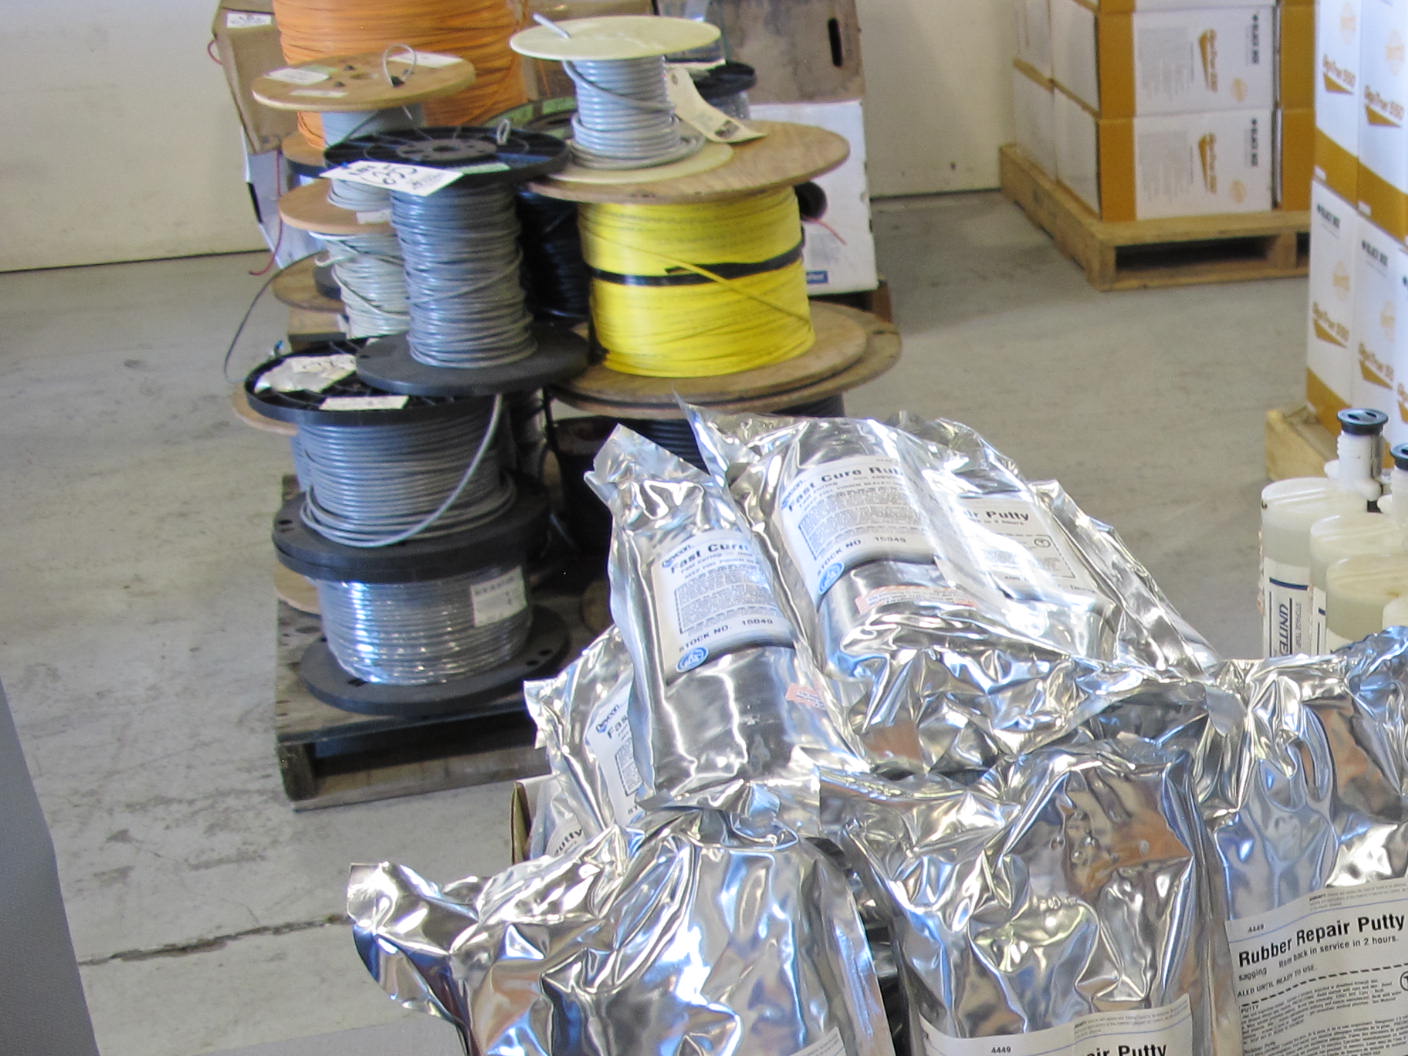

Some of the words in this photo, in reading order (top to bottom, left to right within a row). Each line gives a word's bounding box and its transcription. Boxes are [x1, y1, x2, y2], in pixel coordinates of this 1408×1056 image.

[985, 510, 1030, 521] Putty
[1238, 938, 1293, 968] Rubber
[1296, 919, 1350, 947] Repair
[1357, 913, 1406, 933] Putty
[1238, 966, 1268, 983] sagging
[1309, 946, 1318, 957] in
[1319, 939, 1350, 954] service
[1352, 937, 1361, 948] in
[1363, 936, 1369, 946] 2
[1371, 934, 1400, 945] hours.
[991, 1046, 1012, 1054] 4449
